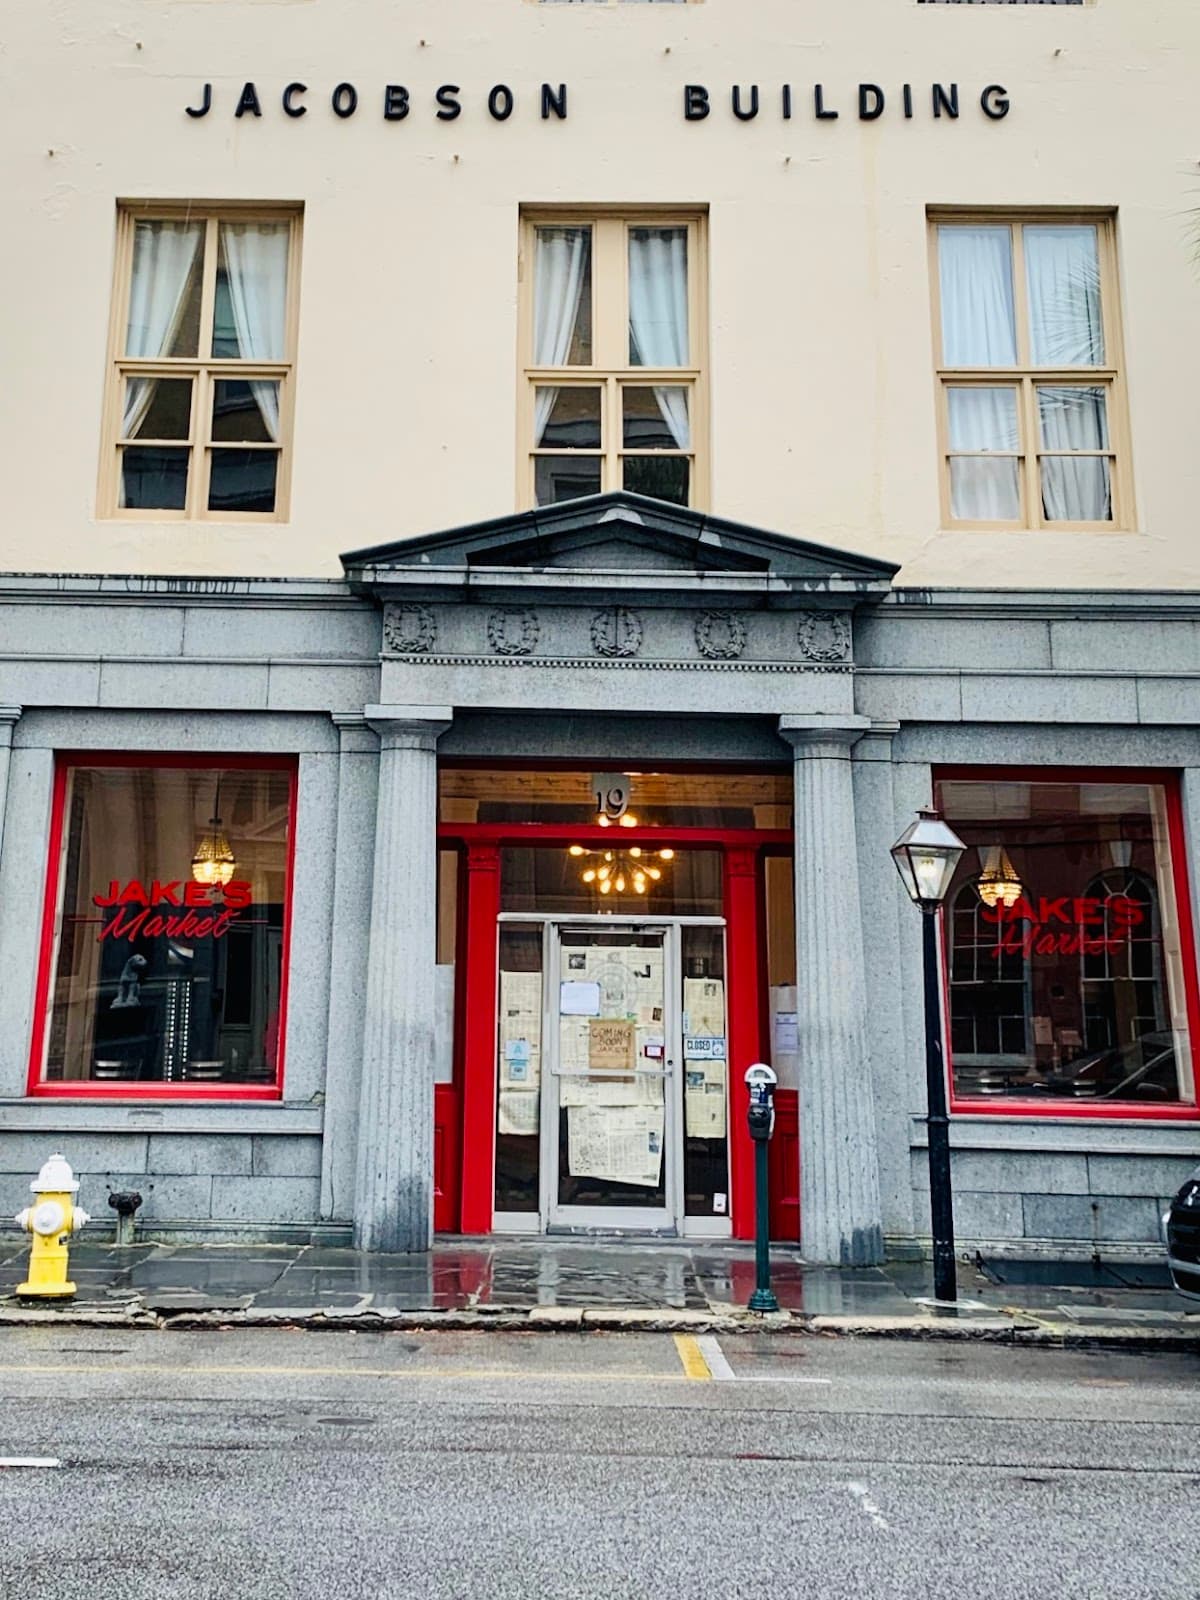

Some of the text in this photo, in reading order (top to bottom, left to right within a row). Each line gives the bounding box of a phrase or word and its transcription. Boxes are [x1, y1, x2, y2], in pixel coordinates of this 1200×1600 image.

[185, 82, 1010, 121] JACOBSON BUILDING
[597, 788, 628, 820] 19
[93, 879, 253, 908] JAKE'S
[96, 907, 241, 943] Market
[982, 896, 1144, 925] JAKE'S
[992, 923, 1130, 960] Market
[591, 1027, 632, 1039] COMING
[687, 1040, 710, 1051] CLOSED
